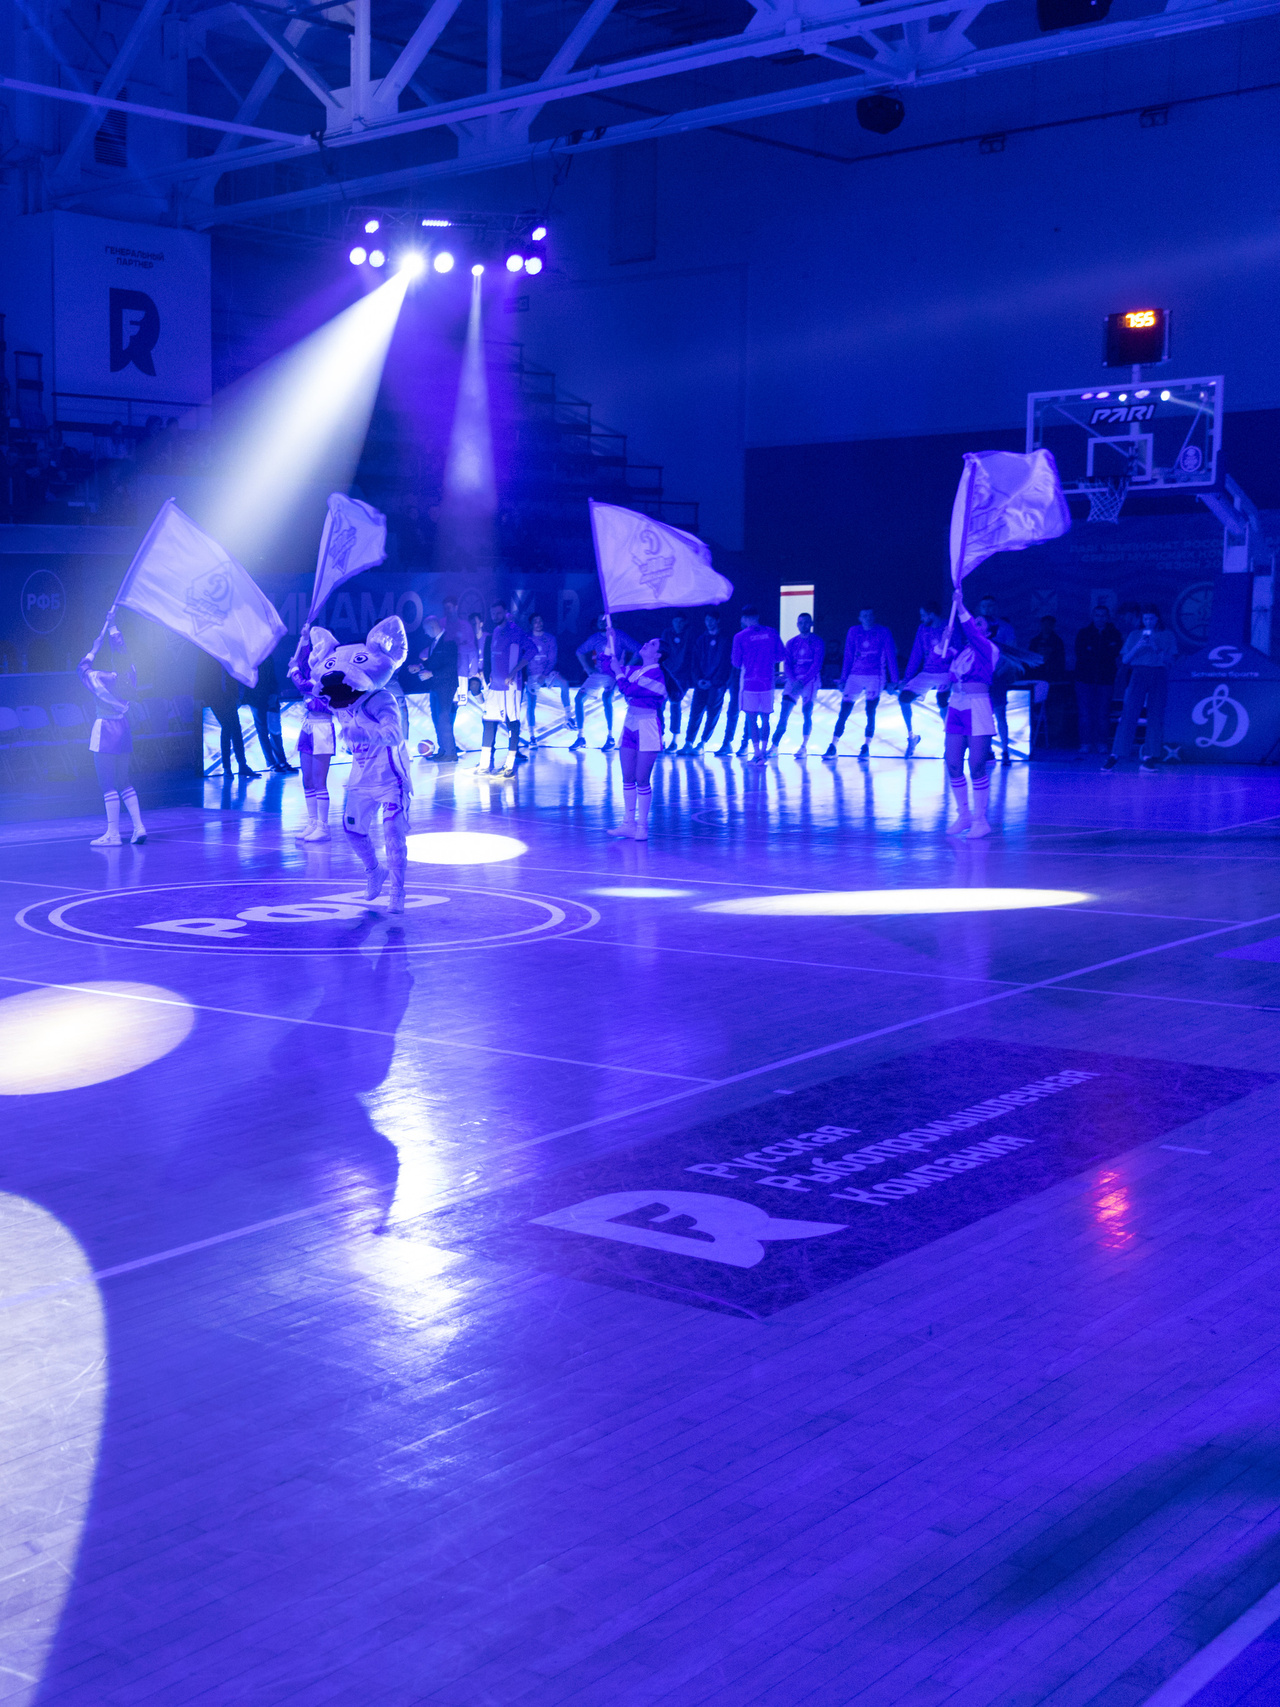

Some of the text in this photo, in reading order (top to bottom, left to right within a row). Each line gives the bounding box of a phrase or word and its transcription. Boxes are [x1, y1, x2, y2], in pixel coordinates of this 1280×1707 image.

[105, 245, 166, 262] ГЕНЕРАЛЬНЫЙ
[116, 257, 154, 269] ПАРТНЕР
[1091, 403, 1155, 425] PARI
[26, 593, 62, 612] РФБ
[268, 590, 424, 635] ИНАМО
[756, 1068, 1101, 1193] Рыбопромышленная
[685, 1123, 861, 1180] Русская
[829, 1134, 1036, 1206] Компания
